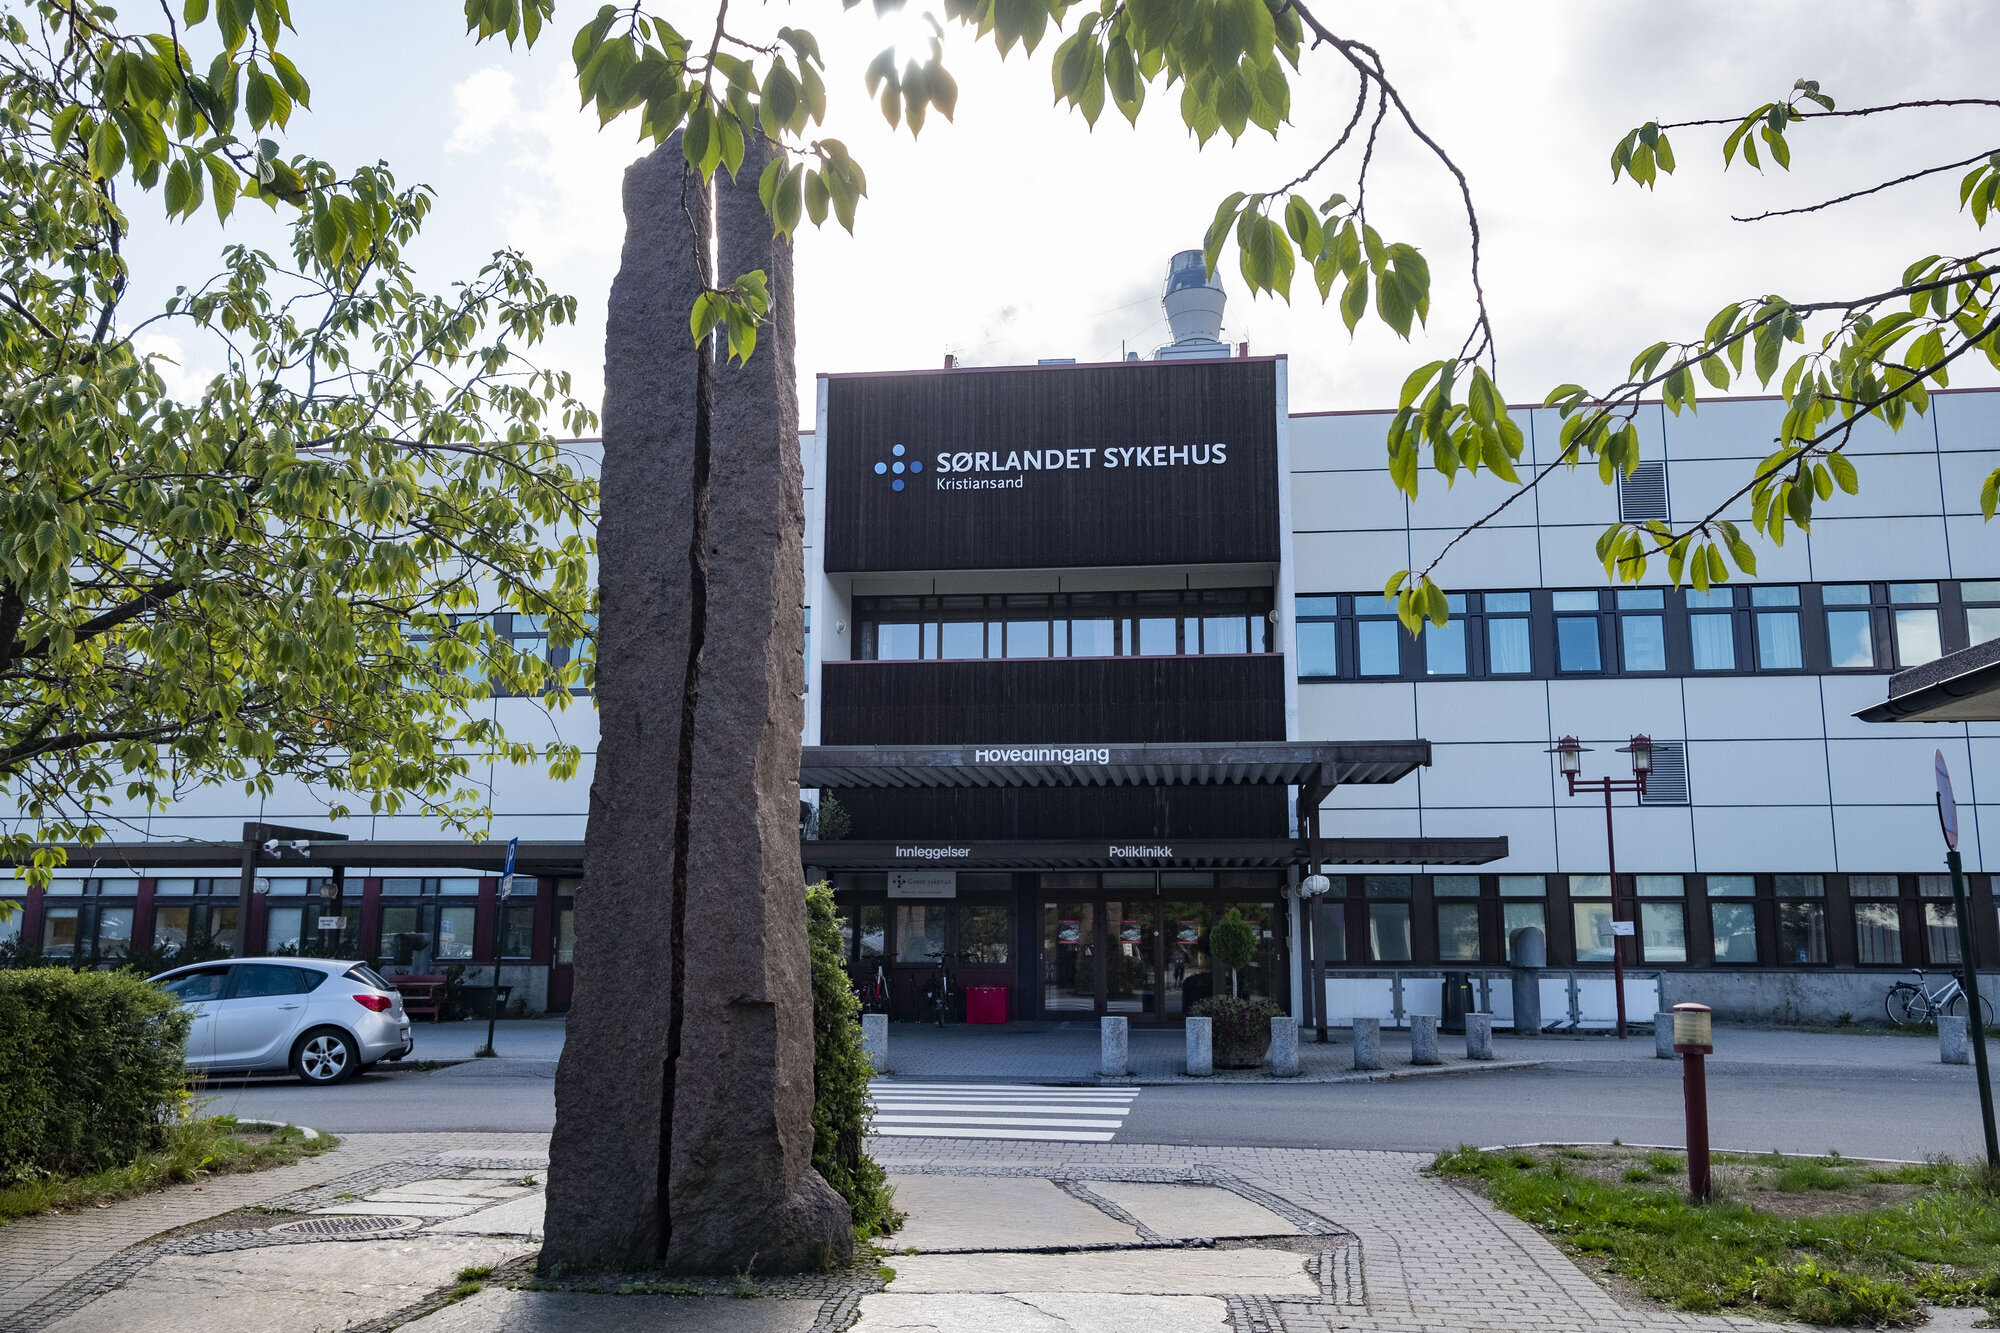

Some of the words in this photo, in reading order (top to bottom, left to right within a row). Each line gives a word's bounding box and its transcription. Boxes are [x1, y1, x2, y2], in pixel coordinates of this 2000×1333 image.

[936, 447, 1096, 473] SØRLANDET
[1103, 443, 1227, 469] SYKEHUS
[936, 475, 1024, 491] Kristiansand
[975, 748, 1110, 765] Hovedinngang
[506, 843, 515, 873] P
[895, 845, 971, 860] Innleggelser
[1109, 845, 1173, 858] Poliklinikk
